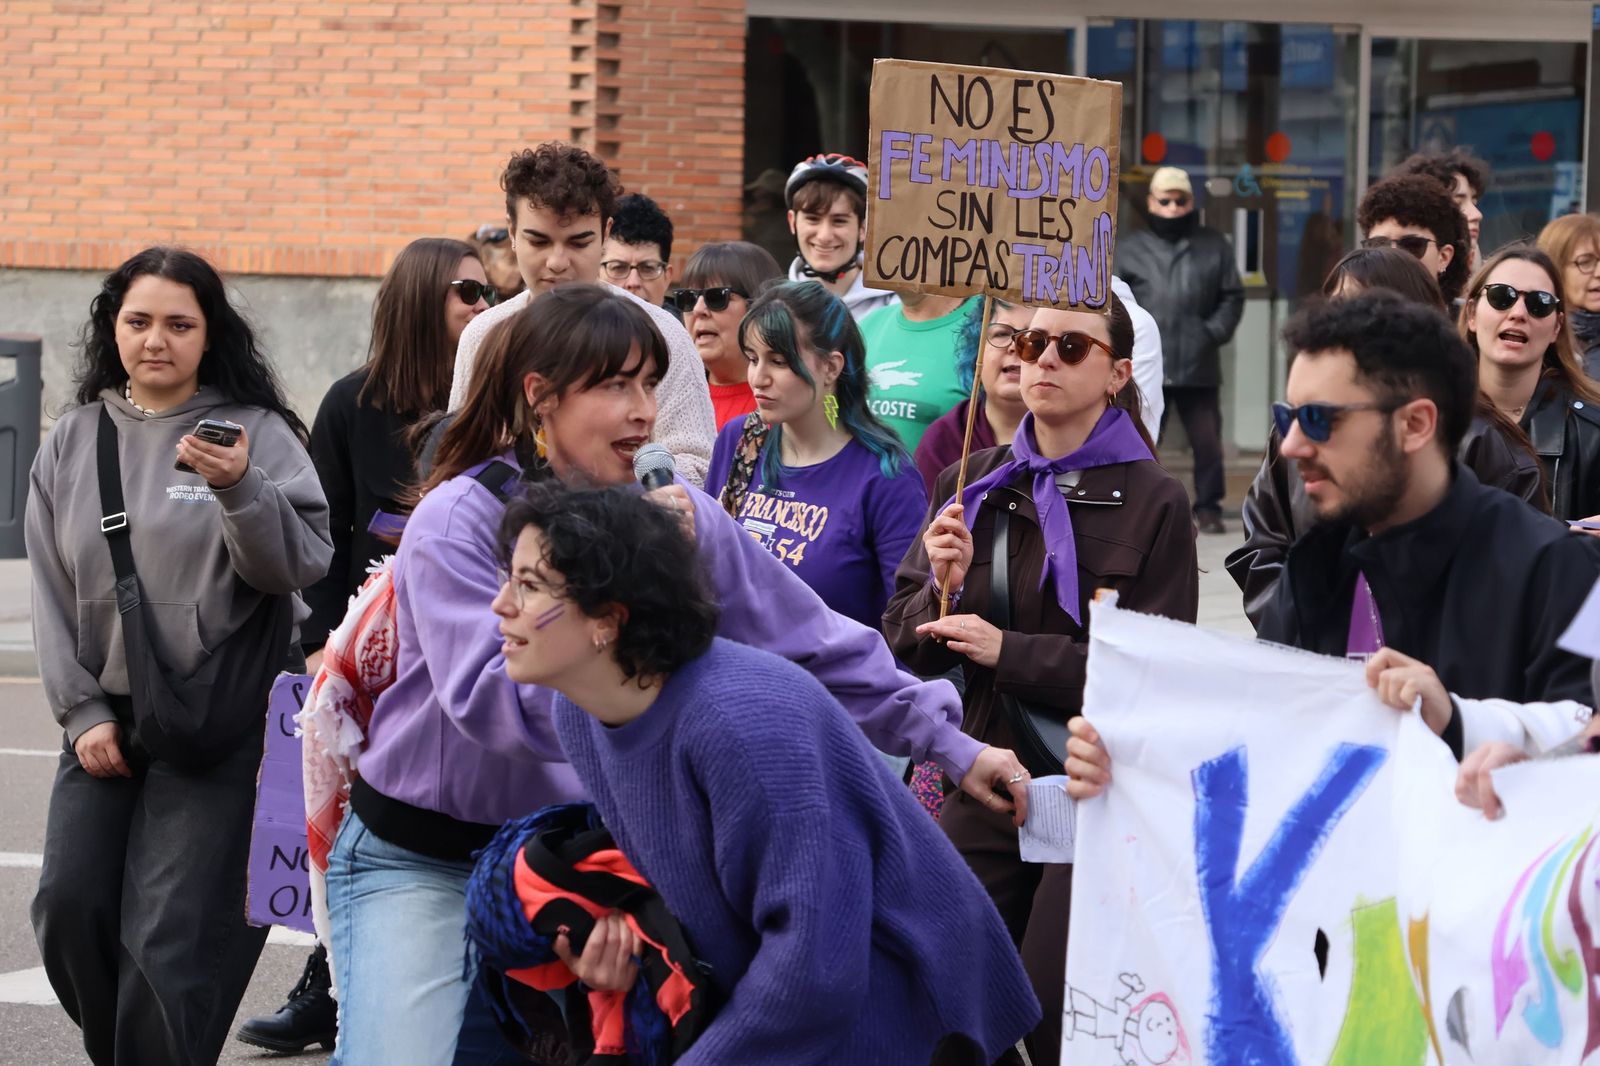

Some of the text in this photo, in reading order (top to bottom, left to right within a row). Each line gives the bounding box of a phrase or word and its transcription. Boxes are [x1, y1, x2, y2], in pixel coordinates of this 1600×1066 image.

[931, 74, 1055, 144] NO ES
[879, 130, 1111, 202] FEMINISMO
[928, 190, 1076, 242] SIN LES
[876, 211, 1112, 307] COMPAS TRANS
[866, 400, 917, 419] COSTE
[169, 492, 194, 500] RODEO
[740, 492, 829, 542] FRANCISCO
